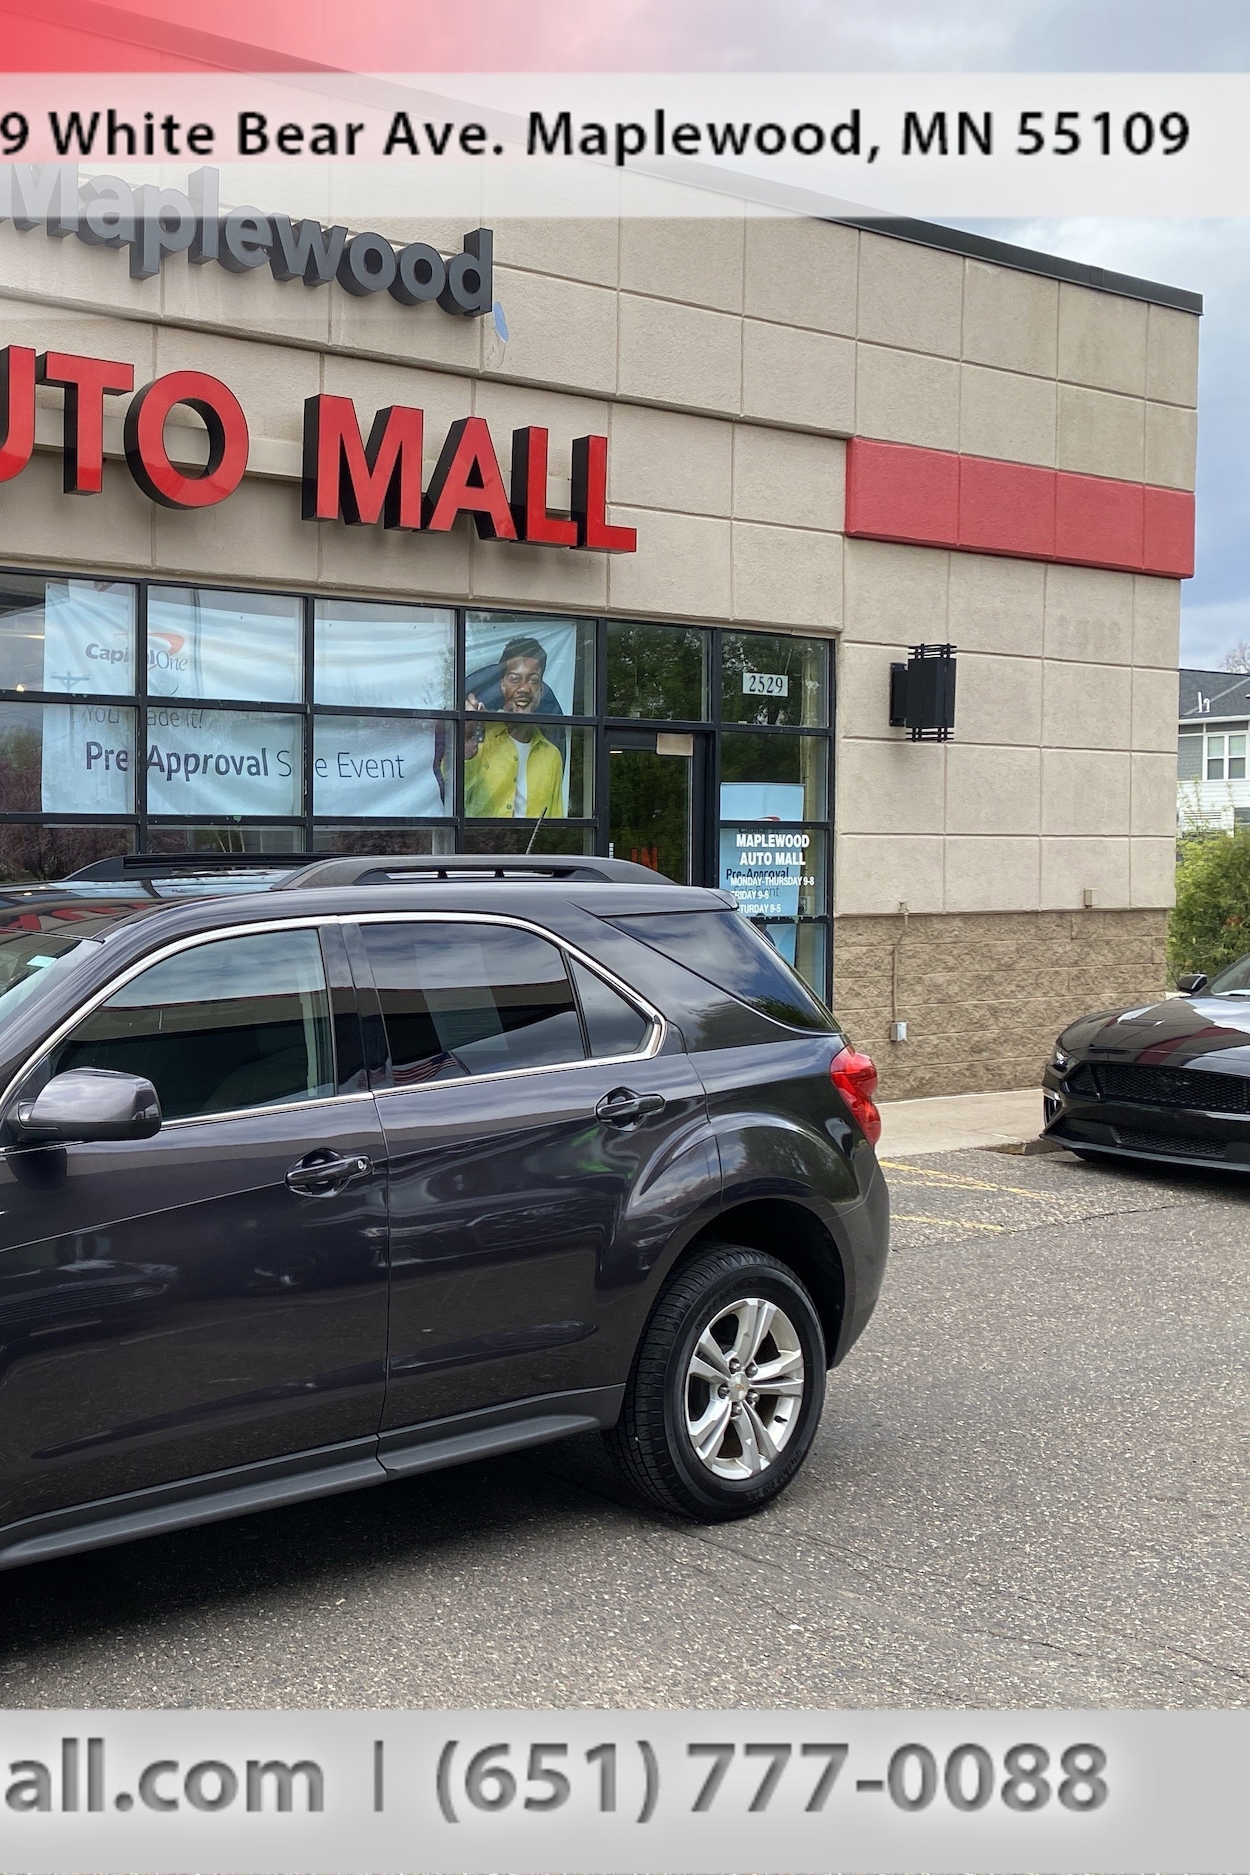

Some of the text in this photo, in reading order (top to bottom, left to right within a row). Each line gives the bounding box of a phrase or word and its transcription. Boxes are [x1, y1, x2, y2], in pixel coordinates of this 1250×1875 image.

[302, 393, 637, 553] MALL
[749, 675, 783, 694] 2529
[86, 705, 120, 724] You
[85, 741, 405, 782] PreApproval Se Event
[736, 833, 811, 848] MAPLEWOOD
[739, 851, 807, 866] AUTO MALL
[730, 876, 815, 887] MONDAY-THURSDAY 9-8
[758, 890, 770, 900] 9-6
[738, 904, 782, 914] TURDAY 9-5
